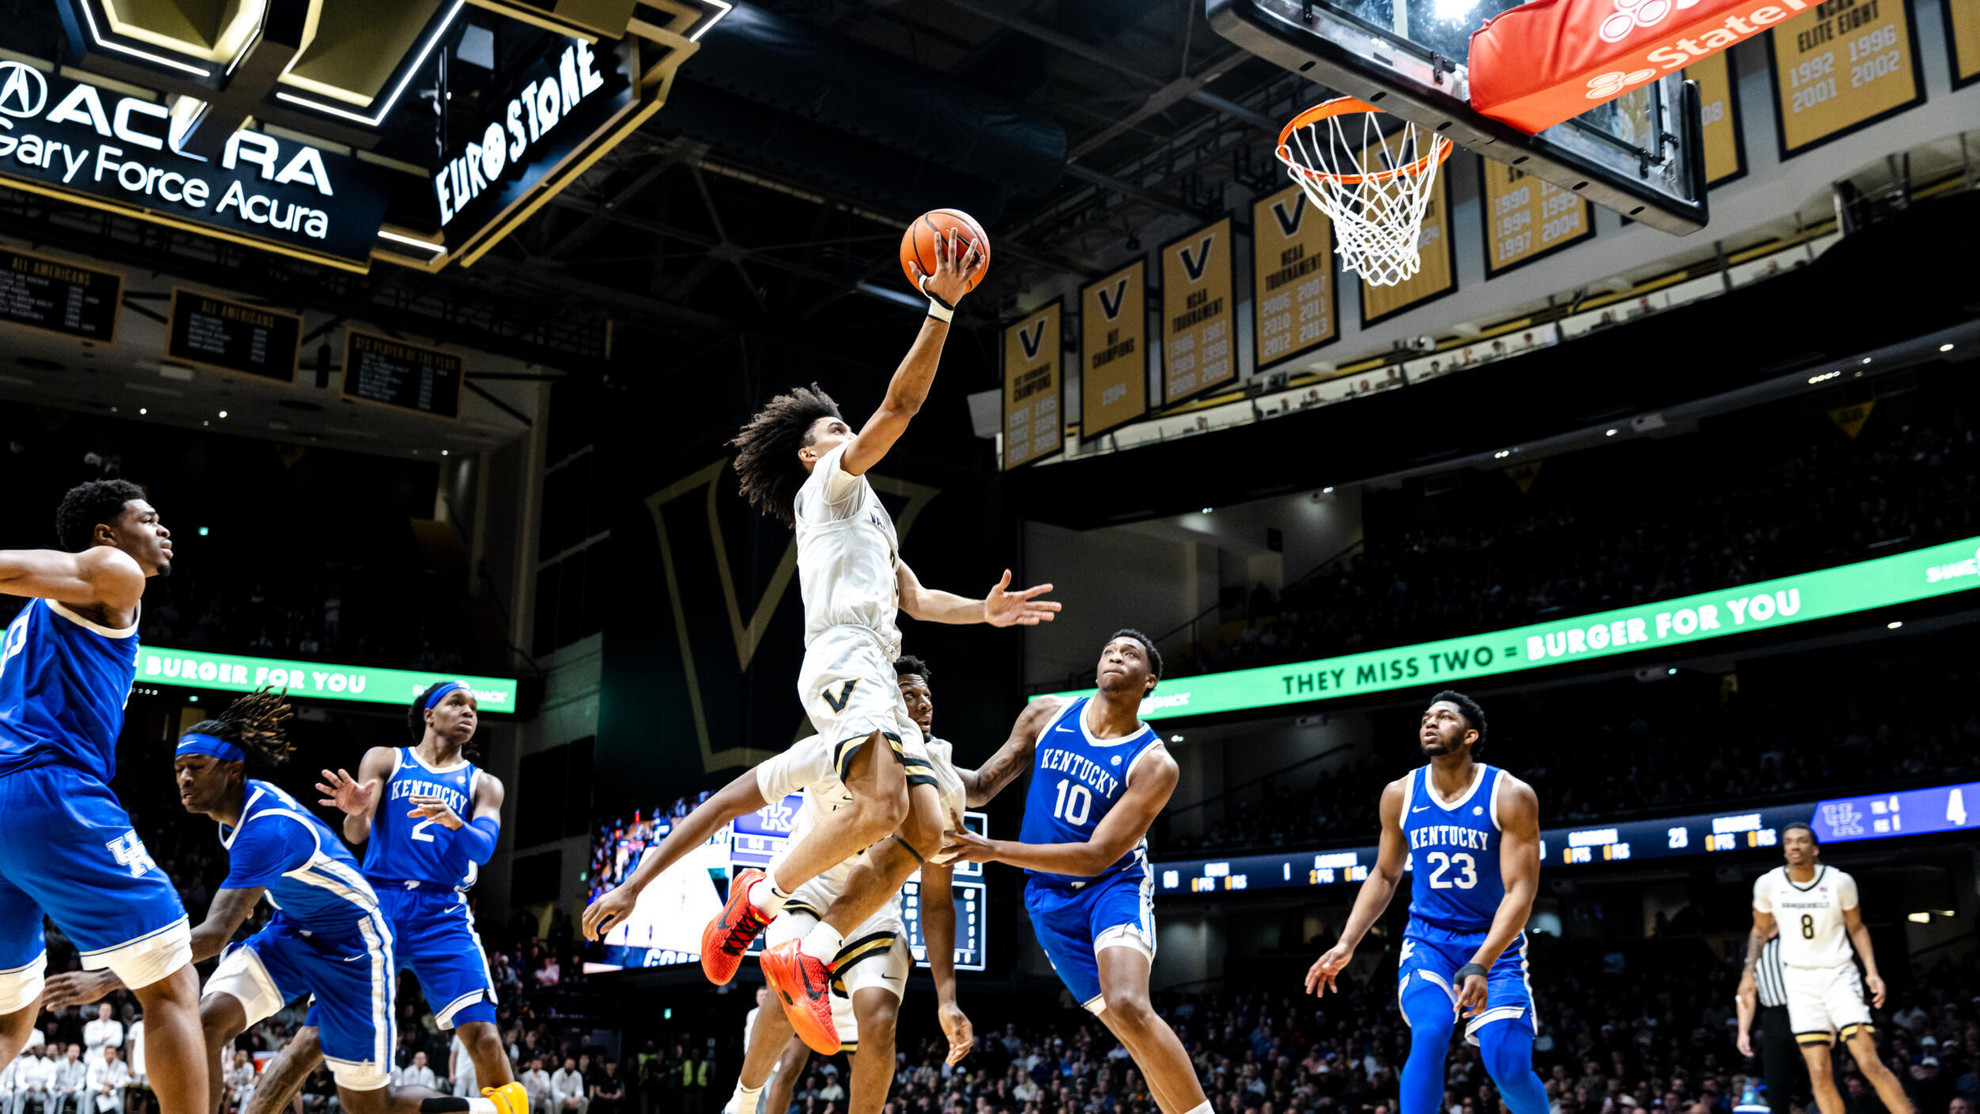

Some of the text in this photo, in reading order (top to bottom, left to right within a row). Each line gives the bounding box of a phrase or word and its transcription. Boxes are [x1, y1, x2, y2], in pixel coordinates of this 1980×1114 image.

[1647, 5, 1787, 69] State
[1798, 1, 1878, 53] ELITE EIGHT
[1790, 24, 1896, 88] 1992 1996
[1792, 49, 1900, 113] 2001 2002
[94, 144, 209, 207] Force
[216, 180, 328, 239] Acura
[1495, 186, 1530, 216] 1990
[1496, 209, 1531, 238] 1994
[1499, 211, 1579, 261] 1997 2004
[1176, 233, 1216, 284] V
[1265, 252, 1321, 292] TOURNAMENT
[1281, 243, 1303, 267] NCAA
[1097, 275, 1131, 322] V
[1172, 297, 1223, 334] TOURNAMENT
[1299, 297, 1326, 323] 2011
[1015, 316, 1047, 361] V
[1092, 337, 1134, 370] CHAMPIONS
[1264, 332, 1291, 358] 2012
[1283, 667, 1345, 695] THEY
[1356, 657, 1419, 686] MISS
[1429, 645, 1494, 674] TWO
[1526, 617, 1648, 661] BURGER
[1655, 604, 1721, 639] FOR
[1725, 588, 1802, 625] YOU
[145, 655, 366, 694] BURGER FOR YOU
[822, 678, 860, 715] V
[1040, 748, 1119, 800] KENTUCKY
[391, 779, 468, 815] KENTUCKY
[1053, 778, 1092, 827] 10
[1410, 825, 1488, 851] KENTUCKY
[1426, 851, 1479, 890] 23
[1800, 913, 1815, 940] 8
